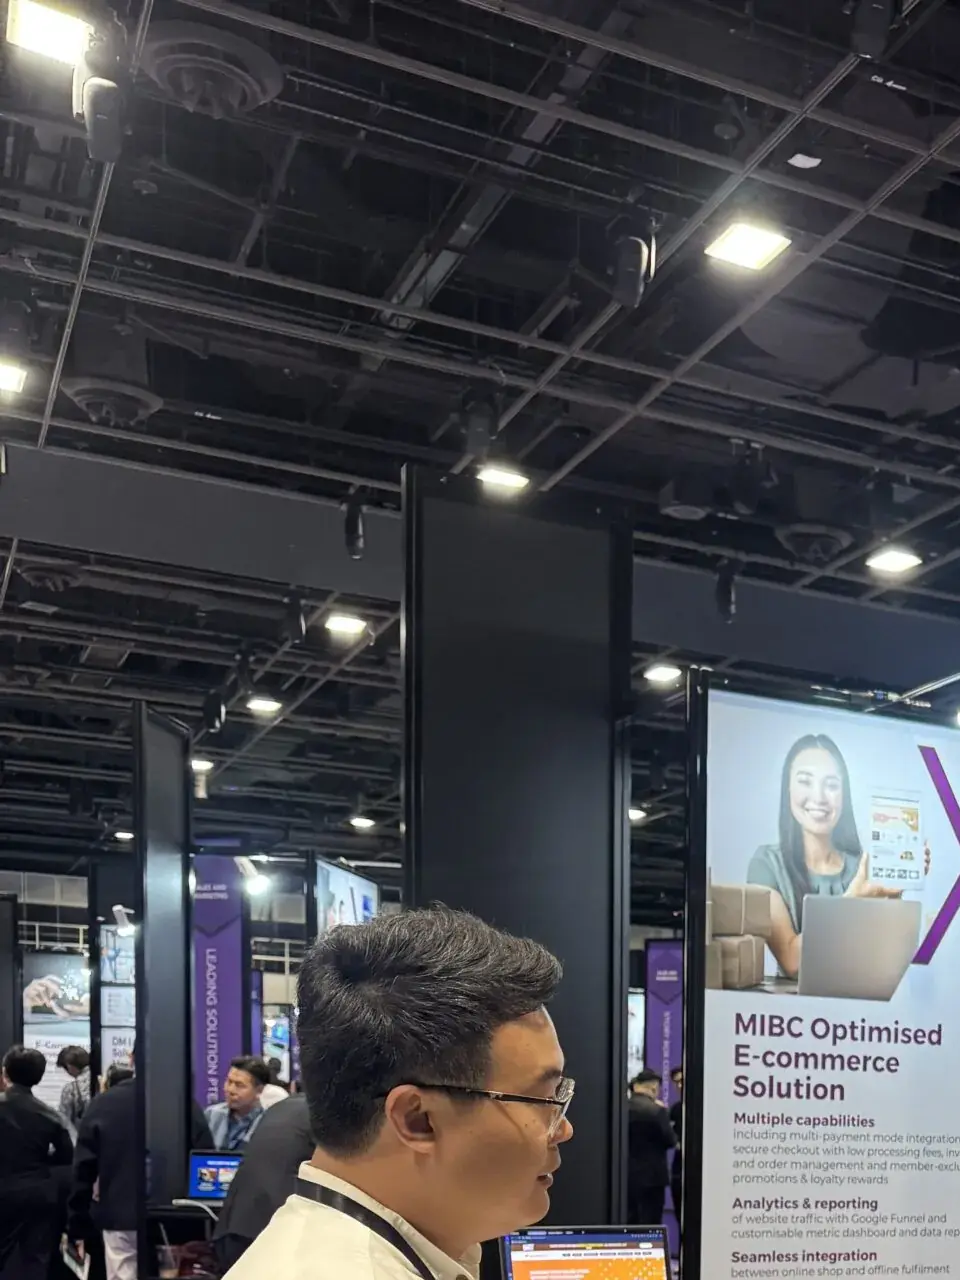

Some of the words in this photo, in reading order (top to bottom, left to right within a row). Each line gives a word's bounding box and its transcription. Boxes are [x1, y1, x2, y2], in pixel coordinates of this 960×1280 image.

[205, 948, 218, 1006] LEADING
[735, 1013, 803, 1038] MIBC
[810, 1018, 942, 1046] Optimised
[205, 1008, 218, 1075] SOLUTION
[734, 1045, 899, 1072] E-commerce
[733, 1076, 845, 1100] Solution
[734, 1113, 792, 1127] Multiple
[796, 1114, 875, 1129] capabilities
[733, 1129, 786, 1141] including
[789, 1132, 870, 1143] multi-payment
[873, 1133, 903, 1143] mode
[732, 1146, 768, 1154] secure
[771, 1145, 819, 1155] checkout
[822, 1146, 844, 1155] with
[847, 1147, 864, 1156] low
[867, 1148, 919, 1158] processing
[922, 1147, 943, 1158] fees,
[732, 1158, 754, 1168] and
[757, 1159, 787, 1169] order
[790, 1161, 863, 1171] management
[867, 1161, 887, 1170] and
[732, 1175, 798, 1186] promotions
[800, 1174, 808, 1184] &
[811, 1174, 844, 1186] loyalty
[847, 1174, 889, 1185] rewards
[732, 1197, 799, 1212] Analytics
[802, 1198, 811, 1208] &
[814, 1197, 878, 1212] reporting
[732, 1213, 743, 1223] of
[746, 1213, 788, 1223] website
[791, 1213, 823, 1223] traffic
[825, 1213, 849, 1223] with
[851, 1213, 888, 1225] Google
[891, 1213, 925, 1223] Funnel
[928, 1212, 947, 1223] and
[731, 1228, 803, 1238] customisable
[806, 1228, 840, 1238] metric
[842, 1227, 896, 1238] dashboard
[899, 1227, 918, 1237] and
[920, 1227, 942, 1237] data
[731, 1250, 799, 1263] Seamless
[802, 1249, 878, 1264] integration
[731, 1267, 779, 1278] between
[781, 1267, 817, 1277] online
[818, 1266, 843, 1278] shop
[845, 1265, 865, 1276] and
[868, 1265, 900, 1275] offline
[901, 1264, 950, 1275] fulfilment
